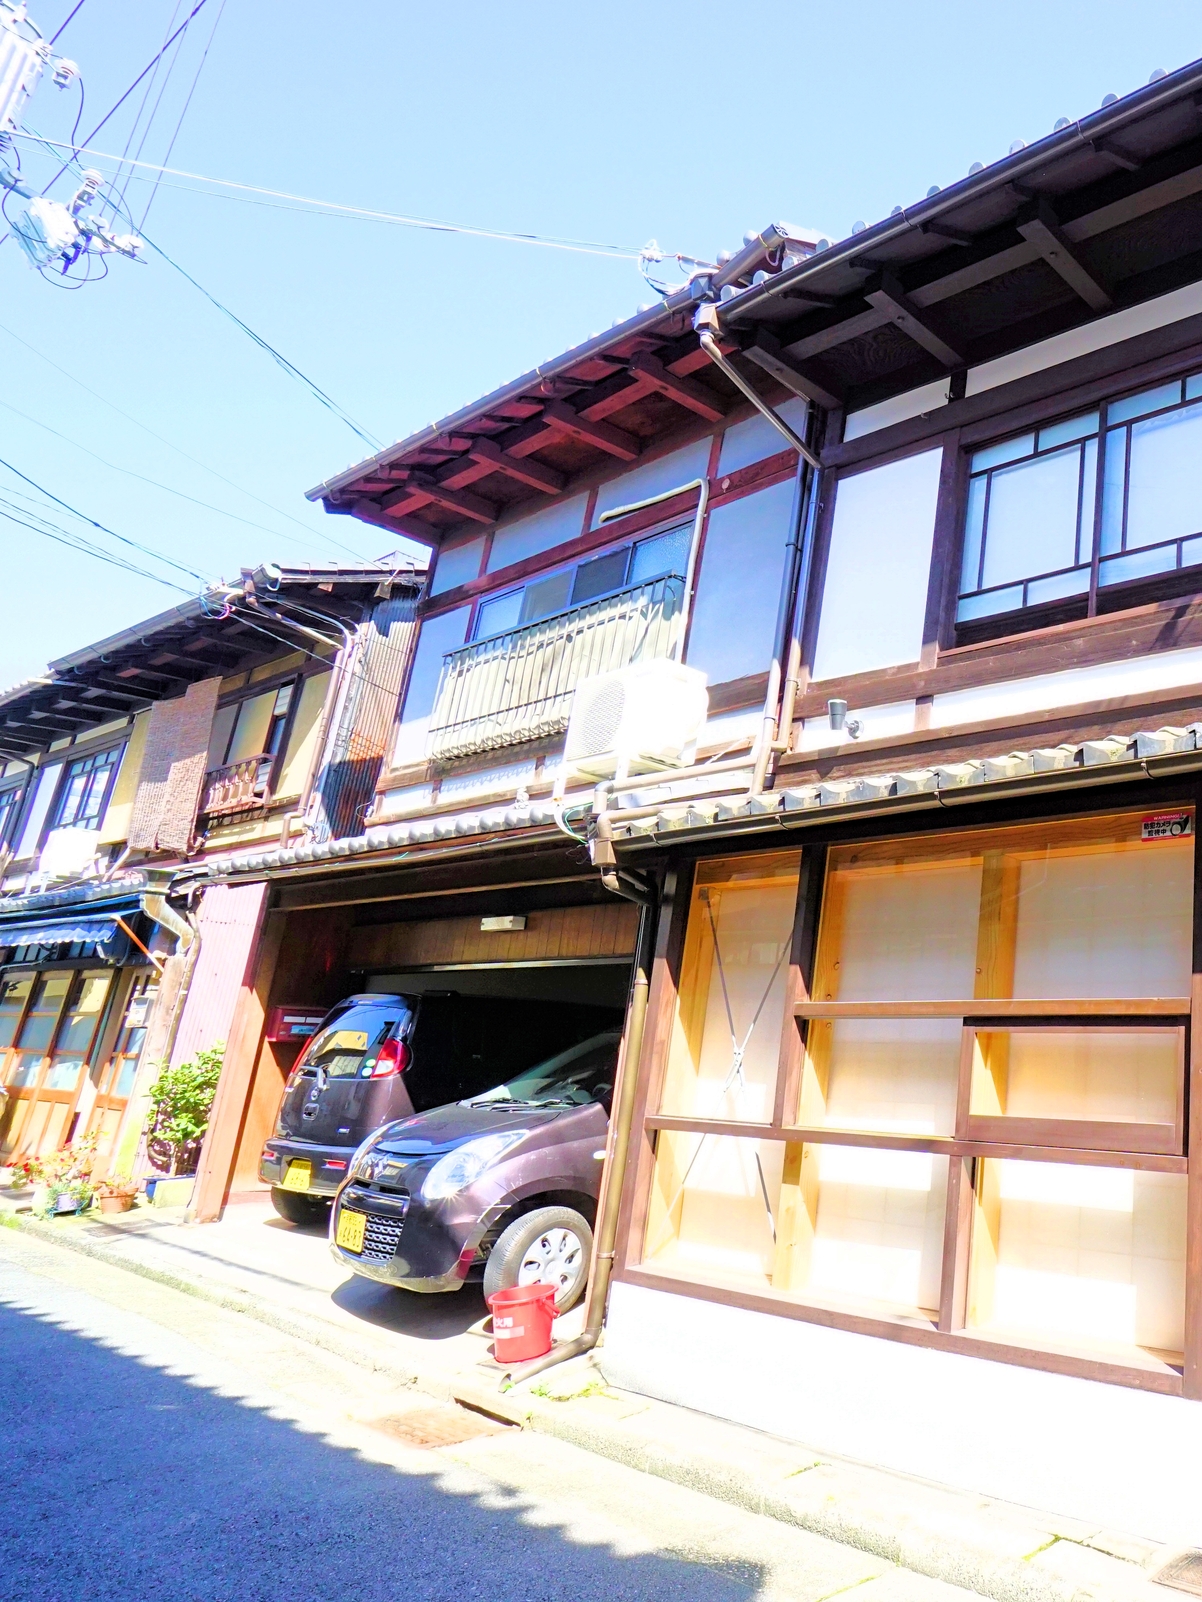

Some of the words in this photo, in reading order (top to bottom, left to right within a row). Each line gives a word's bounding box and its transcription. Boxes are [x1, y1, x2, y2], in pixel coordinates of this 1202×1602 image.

[1144, 821, 1171, 830] 防犯カメラ
